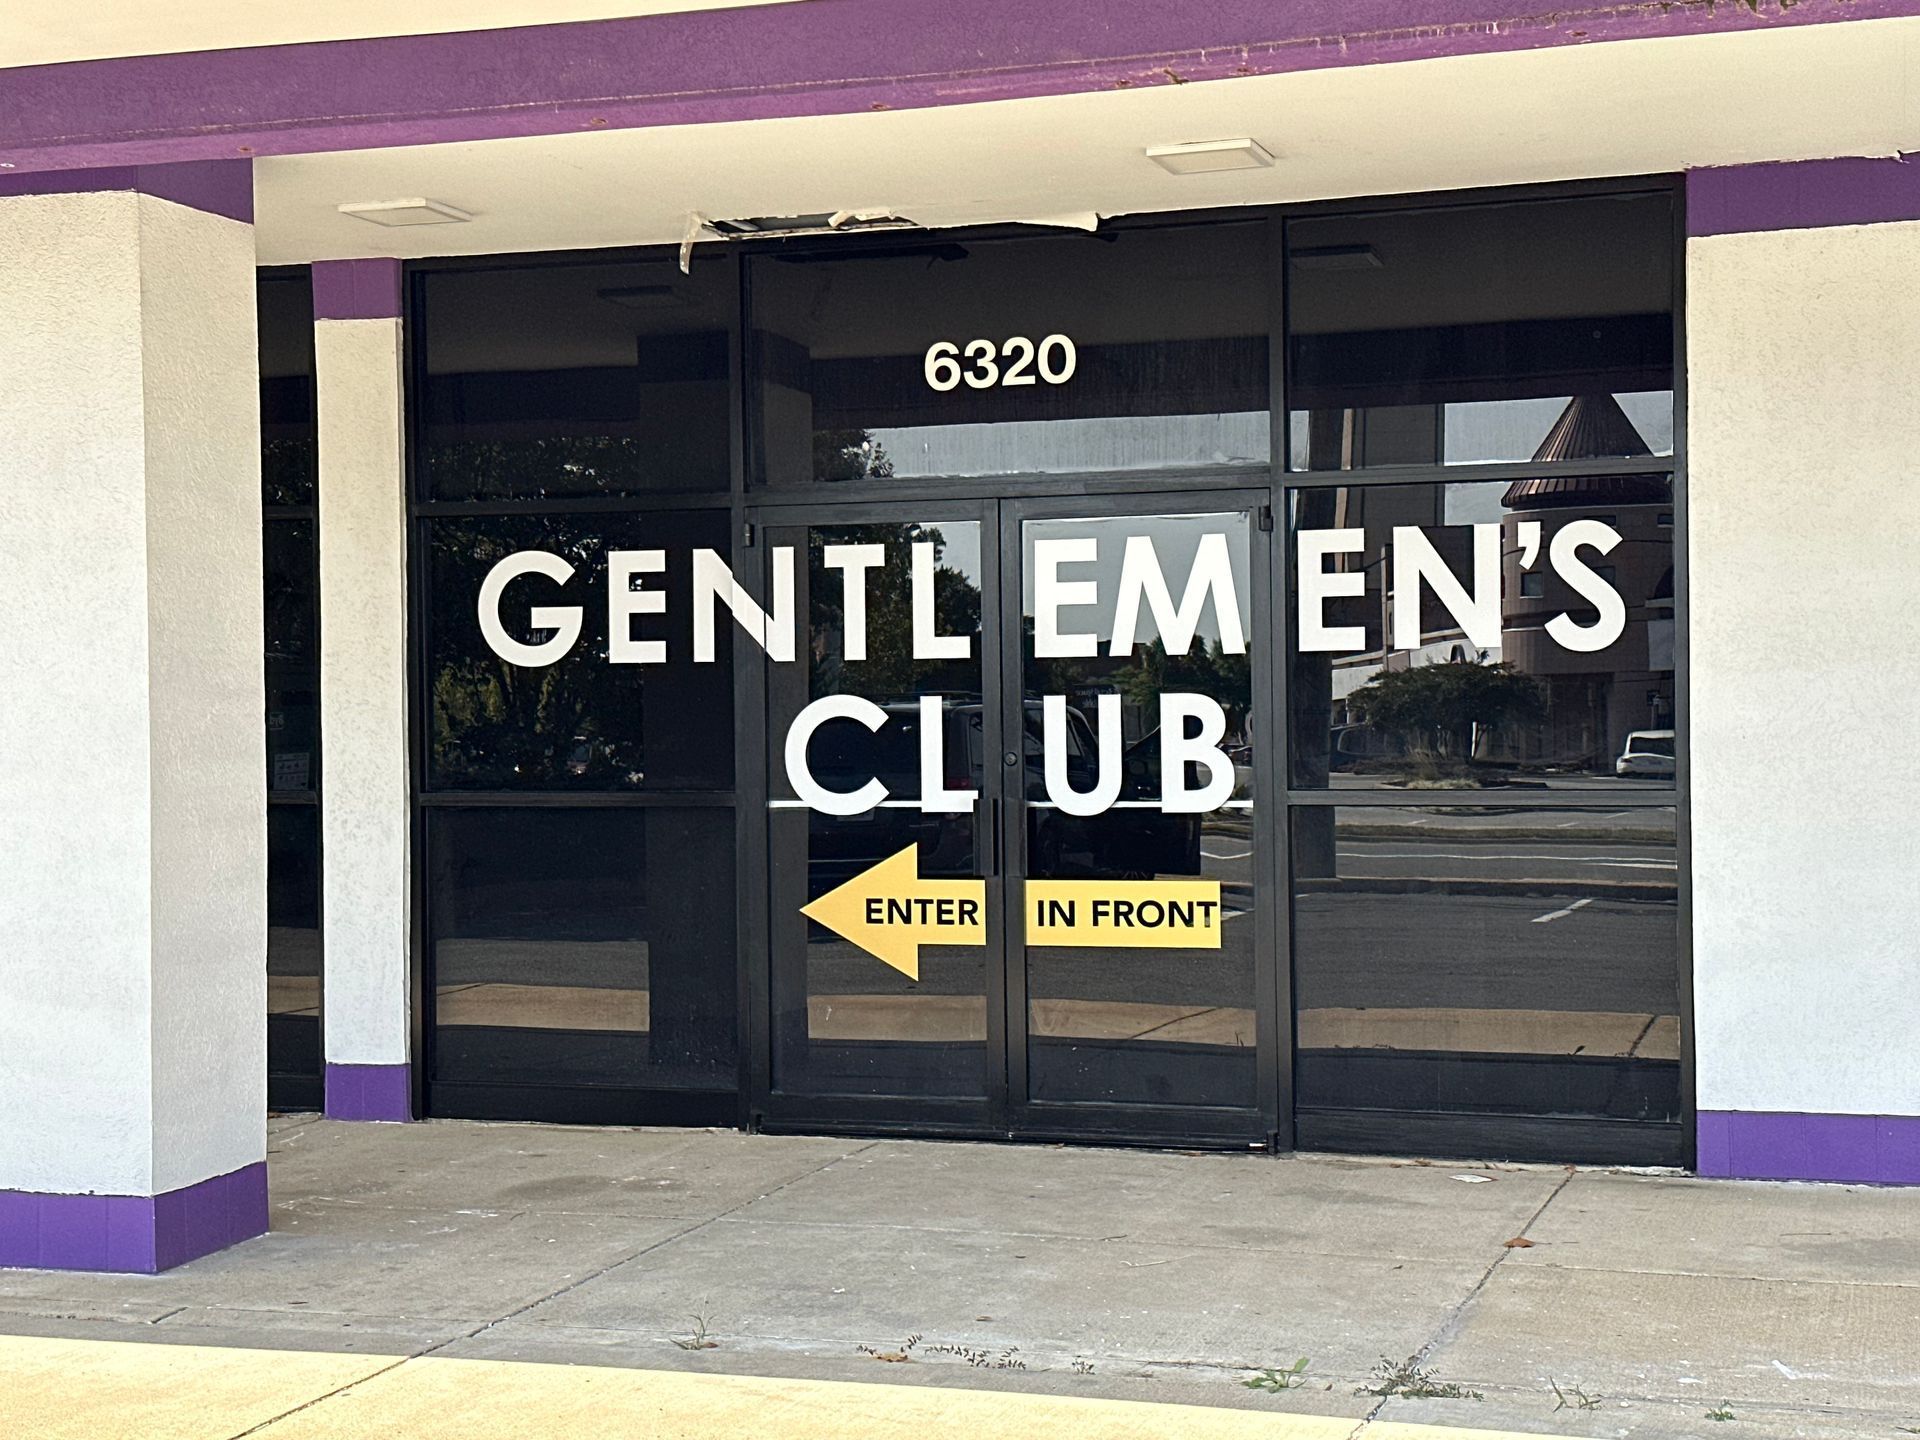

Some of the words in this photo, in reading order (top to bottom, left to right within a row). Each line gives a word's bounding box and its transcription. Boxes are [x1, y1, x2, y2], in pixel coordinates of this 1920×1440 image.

[924, 334, 1076, 391] 6320
[477, 519, 1626, 667] GENTLEMEN'S
[783, 693, 1235, 816] CLUB
[866, 898, 980, 926] ENTER
[1037, 899, 1076, 928] IN
[1091, 899, 1218, 928] FRONT
